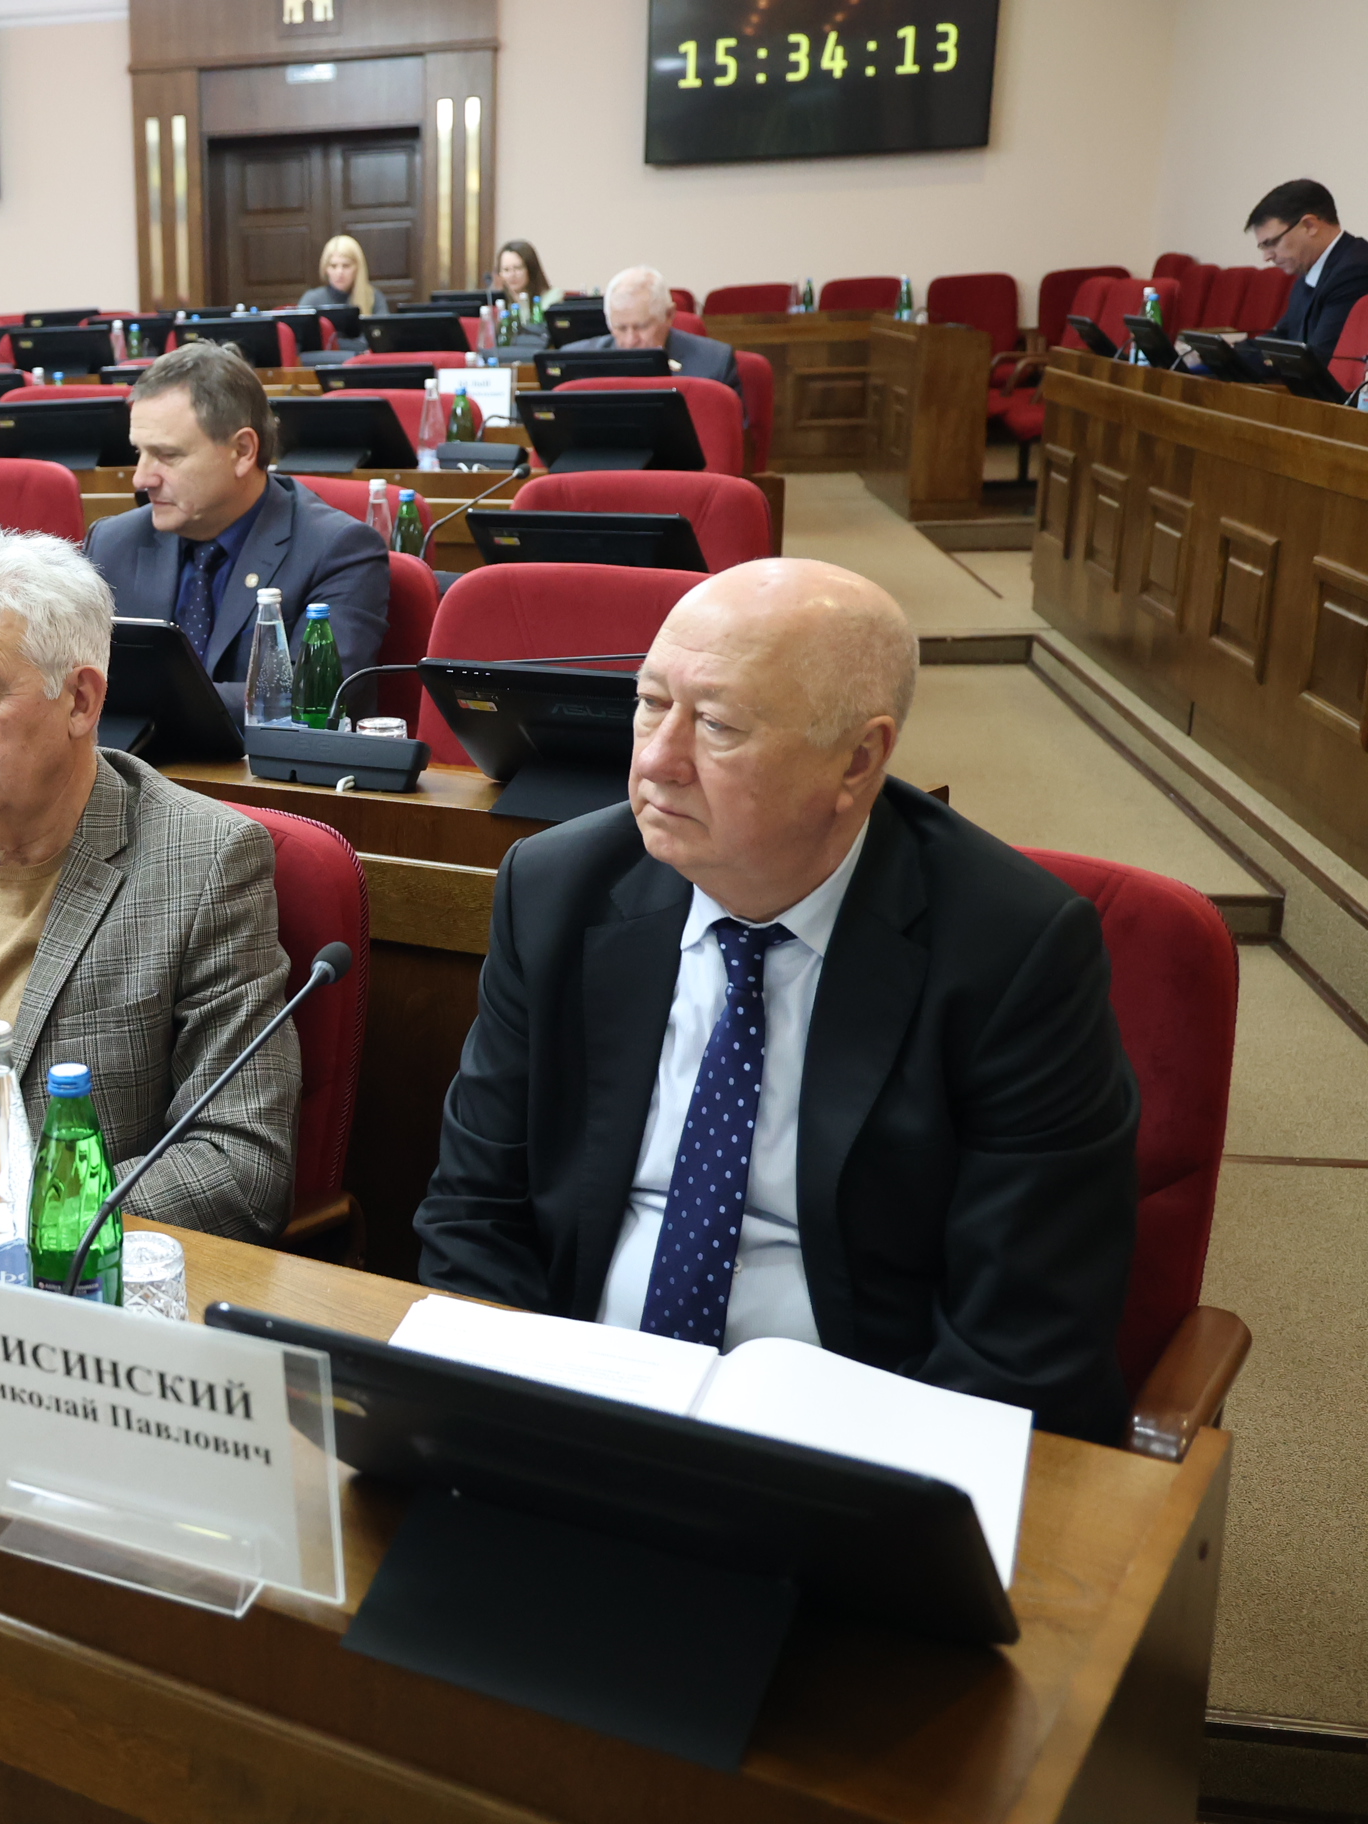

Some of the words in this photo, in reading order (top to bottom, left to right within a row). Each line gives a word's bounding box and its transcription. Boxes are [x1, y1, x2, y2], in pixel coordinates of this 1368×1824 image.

[677, 22, 959, 89] 15:34:13
[551, 703, 628, 720] ASUS
[109, 1402, 274, 1468] Павлович
